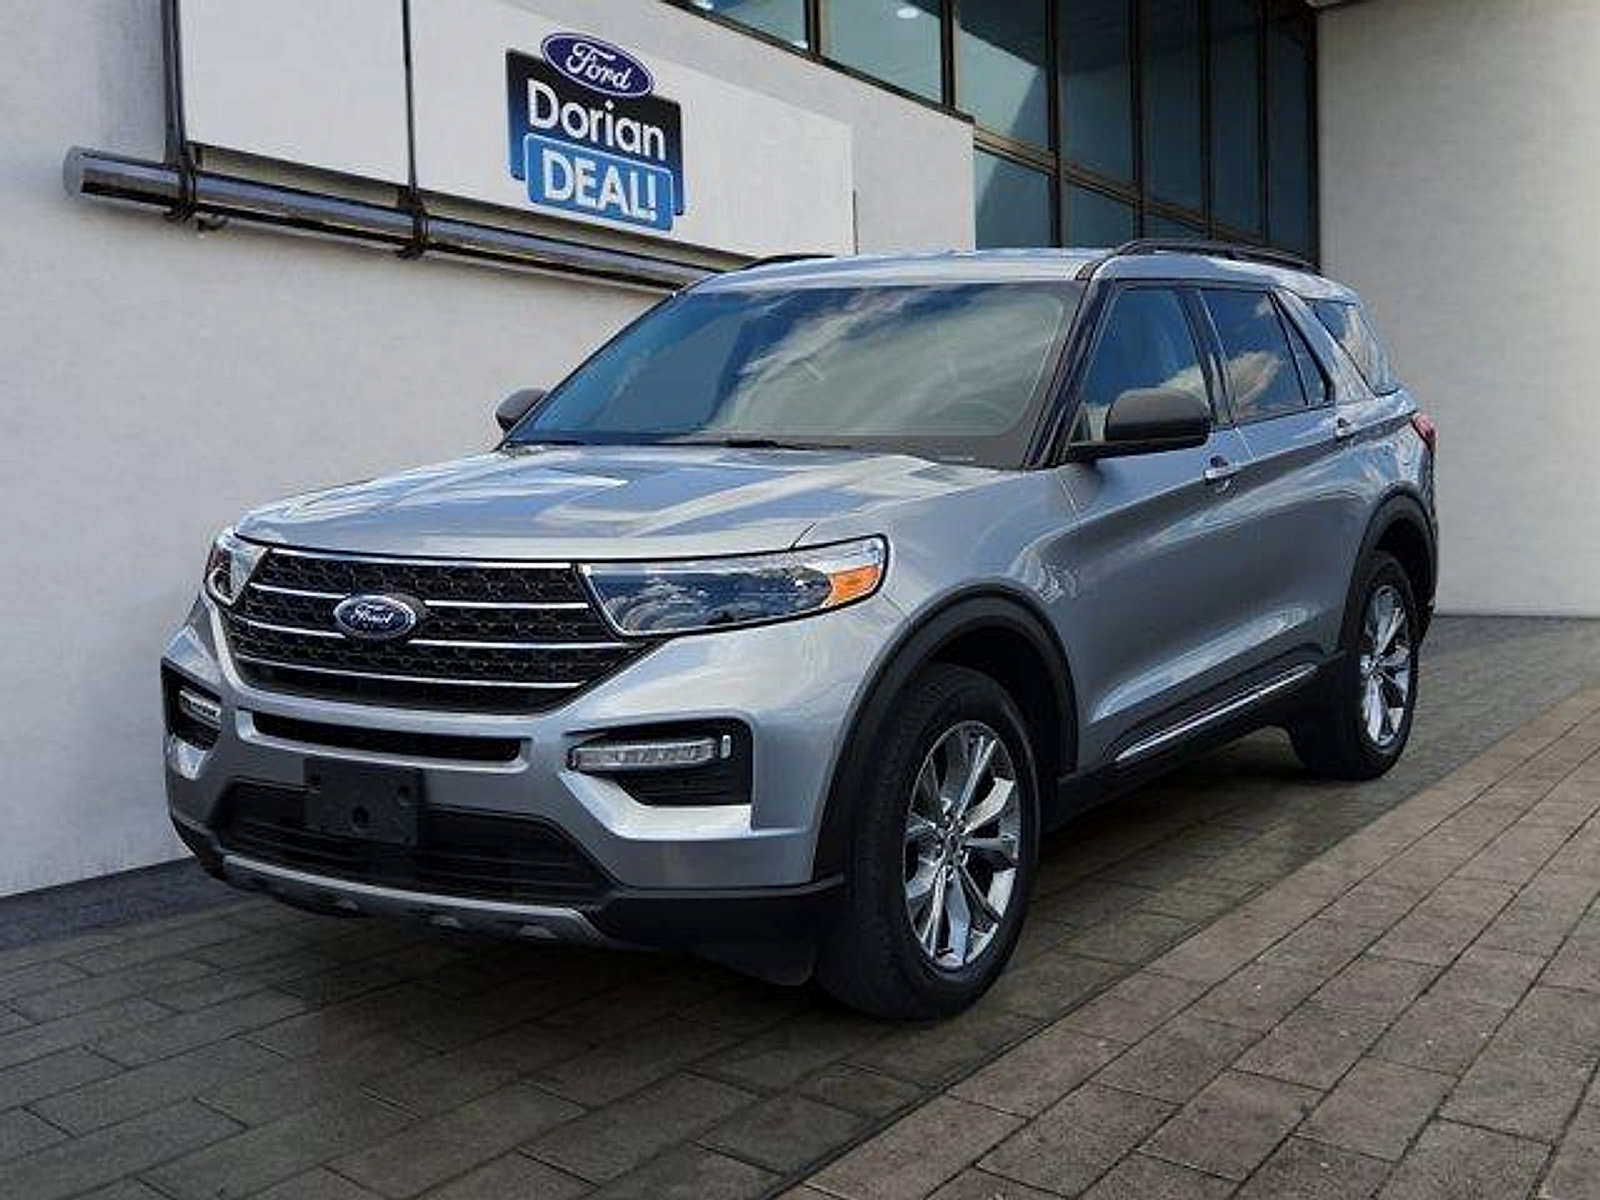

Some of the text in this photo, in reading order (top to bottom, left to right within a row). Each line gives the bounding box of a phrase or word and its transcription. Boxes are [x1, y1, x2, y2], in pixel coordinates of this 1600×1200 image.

[565, 42, 632, 90] Ford
[527, 78, 666, 161] Dorian
[542, 148, 657, 221] DEAL!
[350, 602, 394, 629] Ford
